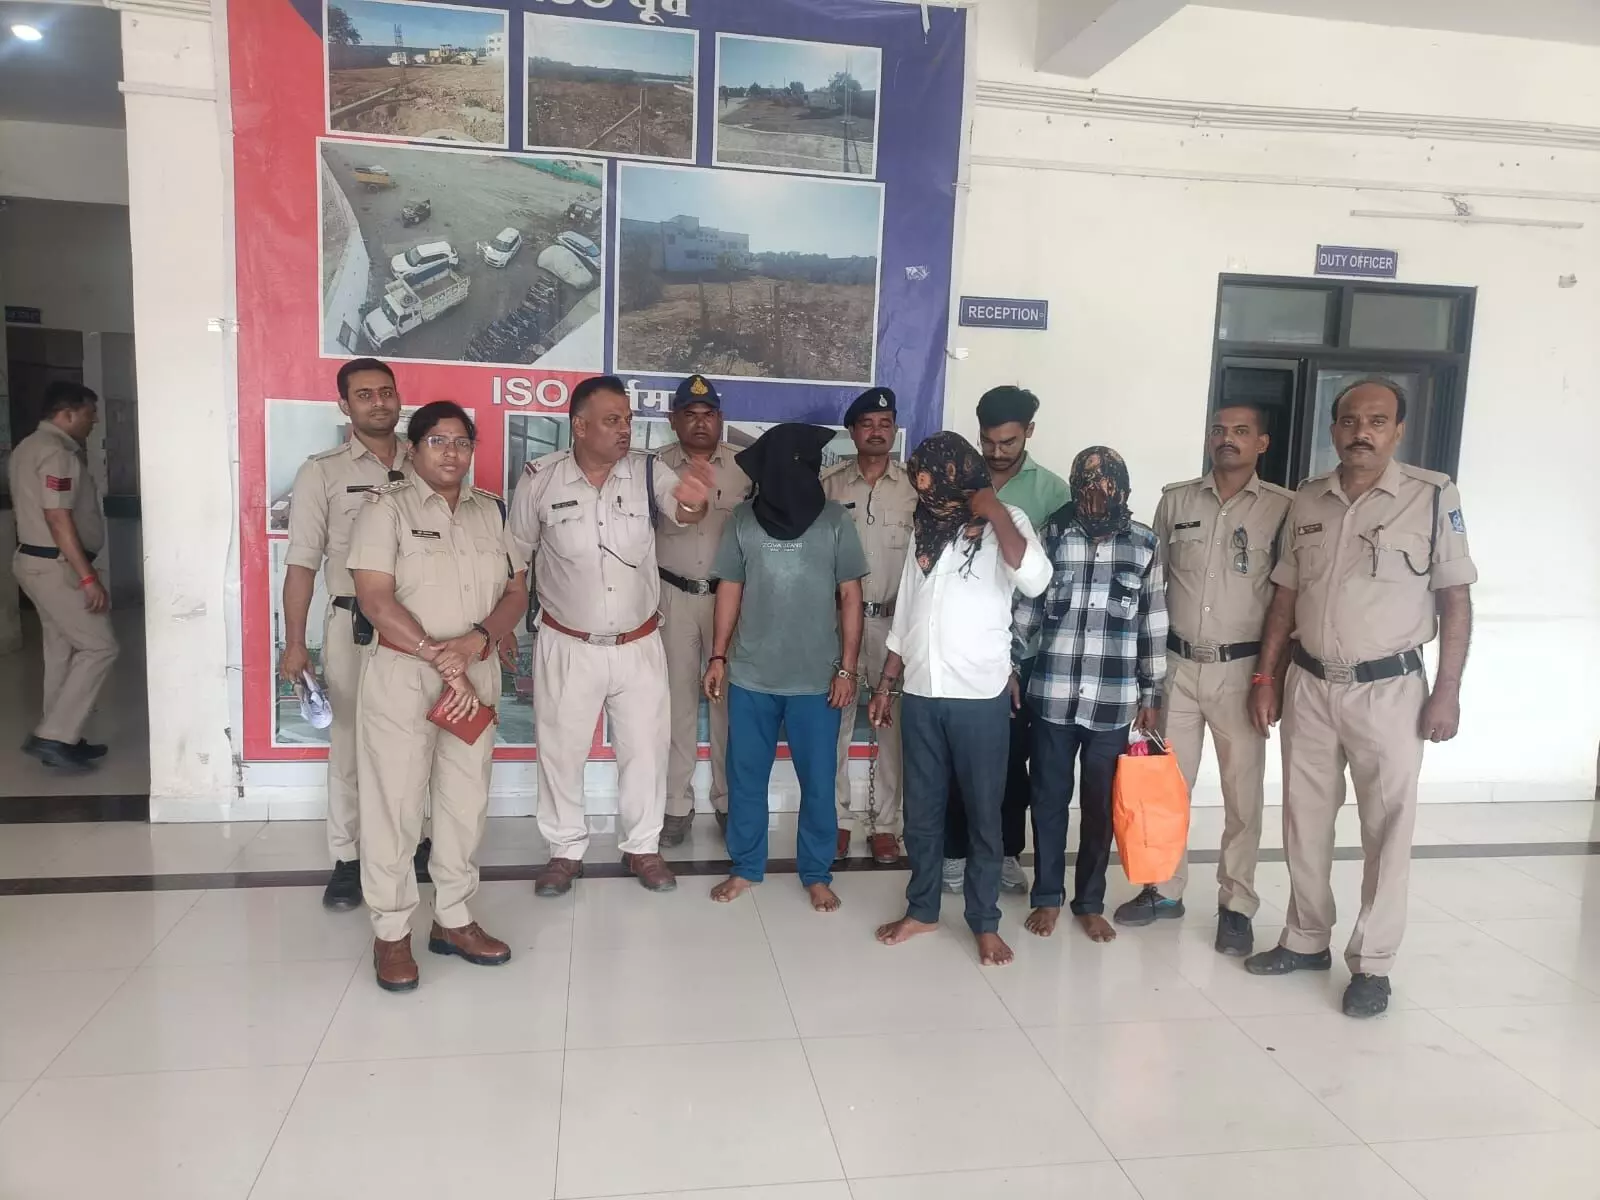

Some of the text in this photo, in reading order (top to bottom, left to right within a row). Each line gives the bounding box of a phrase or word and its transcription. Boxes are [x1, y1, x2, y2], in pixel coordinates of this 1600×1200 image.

[1320, 253, 1393, 269] DUTY OFFICER
[968, 305, 1038, 320] RECEPTION
[492, 376, 569, 407] ISO
